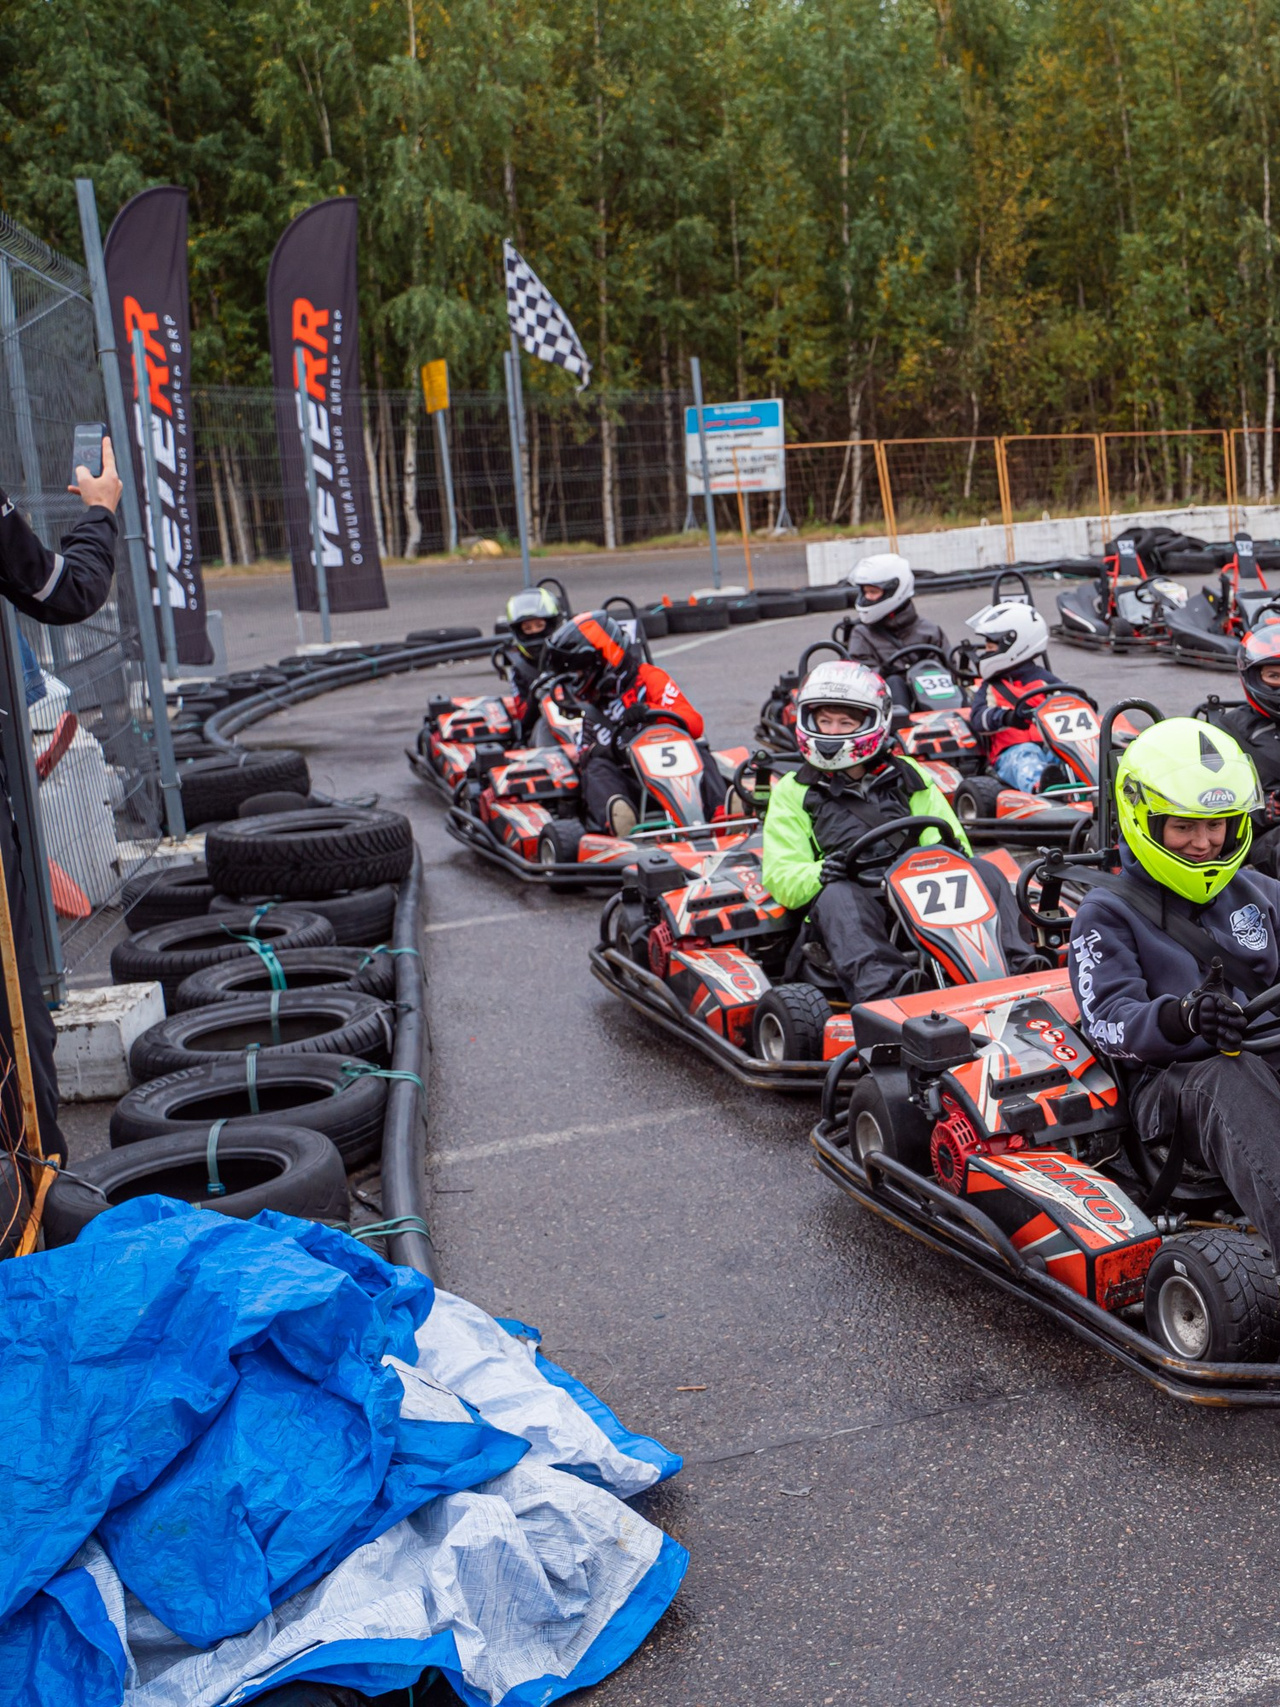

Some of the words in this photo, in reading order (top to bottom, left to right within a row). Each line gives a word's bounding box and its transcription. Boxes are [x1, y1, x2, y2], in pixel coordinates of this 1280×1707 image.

[163, 313, 183, 353] BRP
[922, 678, 952, 690] 38
[1055, 711, 1092, 735] 24
[660, 746, 678, 768] 5
[1200, 790, 1235, 803] Airoh
[916, 874, 968, 915] 27
[1085, 929, 1103, 964] The
[136, 1066, 205, 1098] AEOLUS
[1020, 1158, 1127, 1223] DINO
